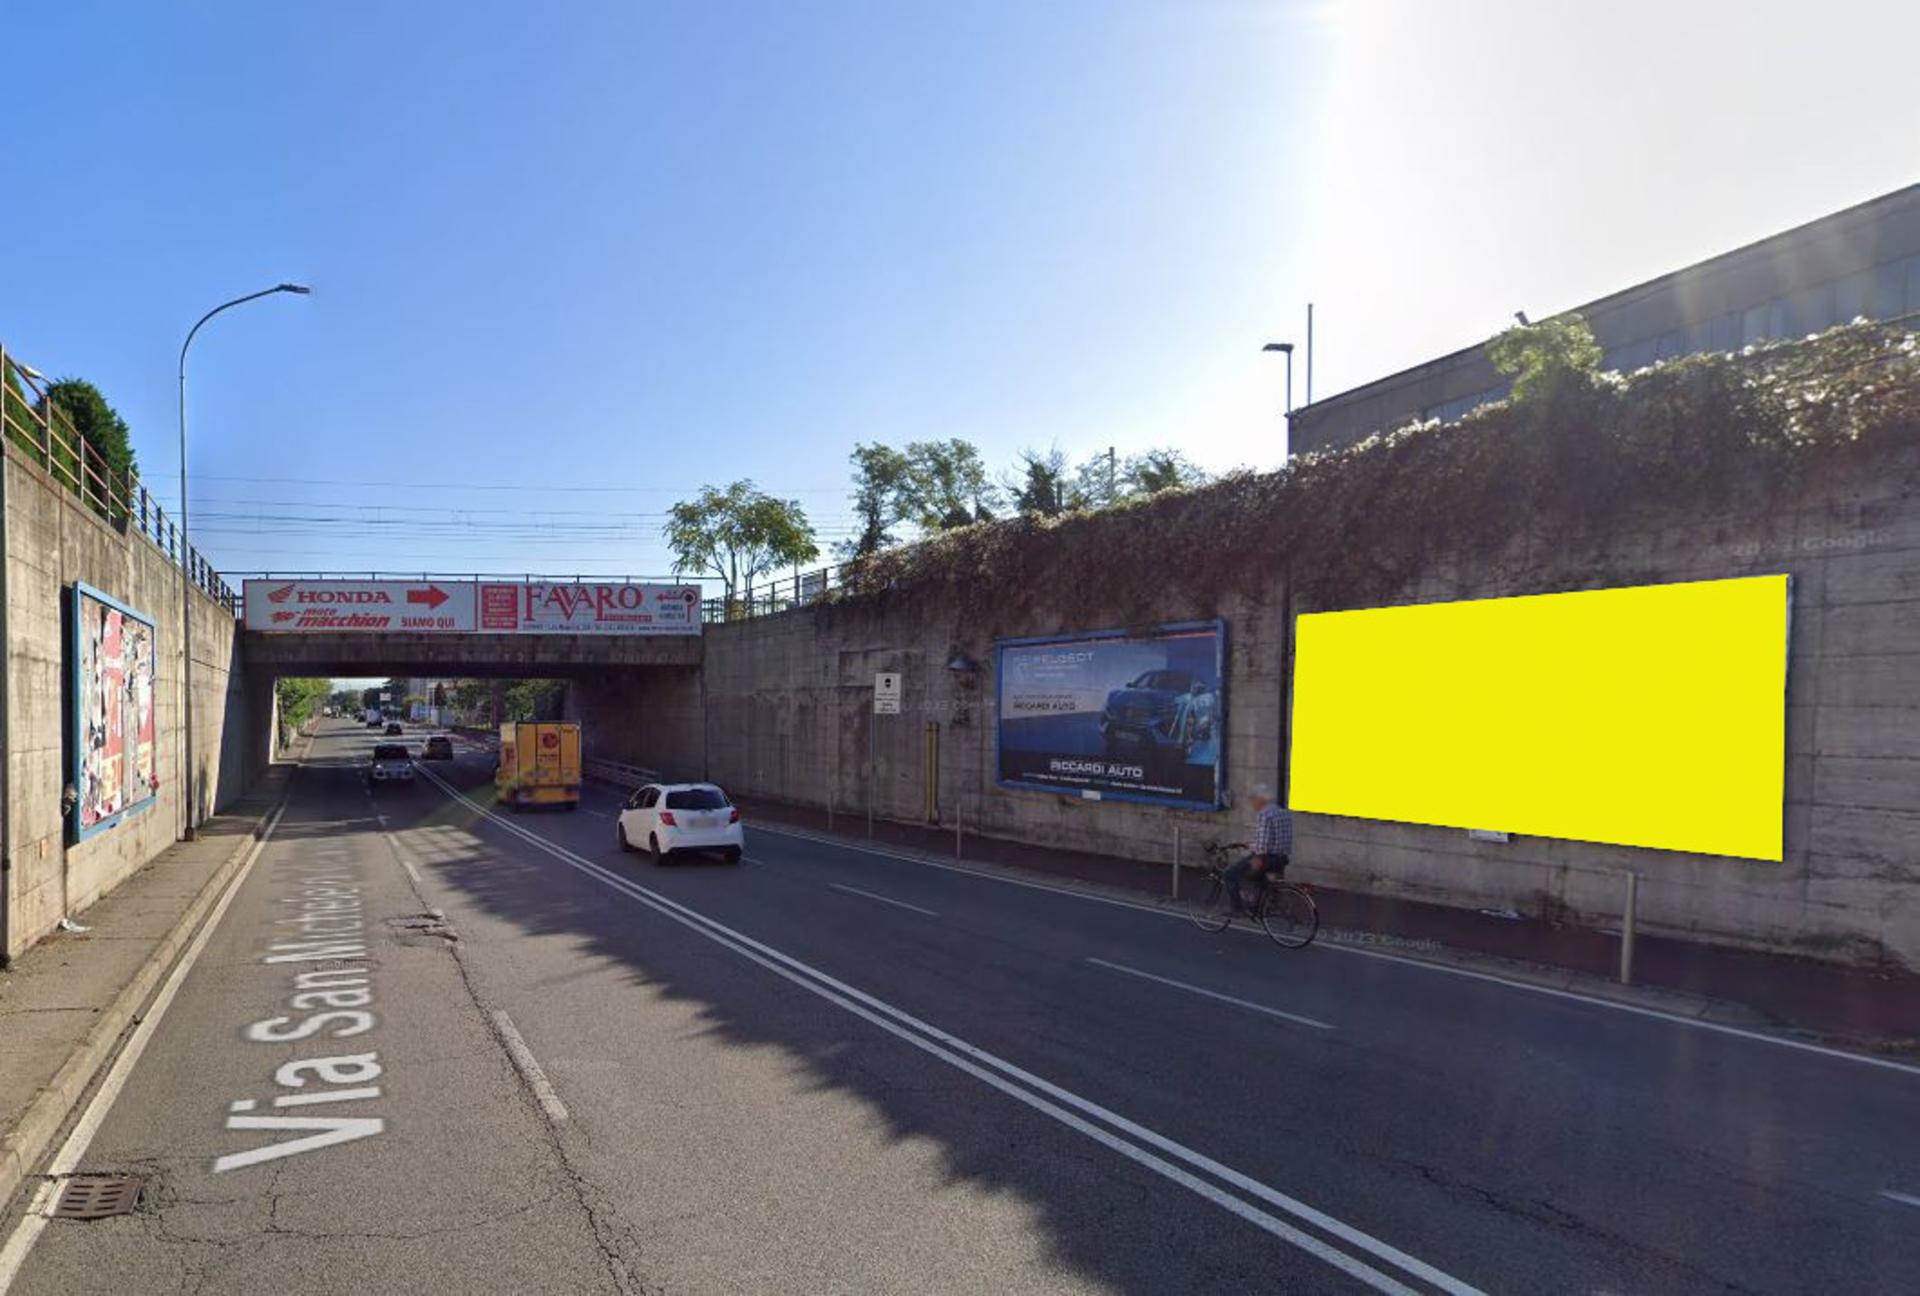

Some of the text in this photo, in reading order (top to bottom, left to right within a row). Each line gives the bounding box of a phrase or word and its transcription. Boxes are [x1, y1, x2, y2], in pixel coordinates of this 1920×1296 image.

[296, 591, 391, 605] HONDA
[523, 584, 644, 621] FAVARO
[303, 608, 338, 617] moto
[295, 613, 391, 628] macchion
[401, 616, 455, 628] SIAMO QUI
[1049, 758, 1144, 779] RICCARDI AUTO
